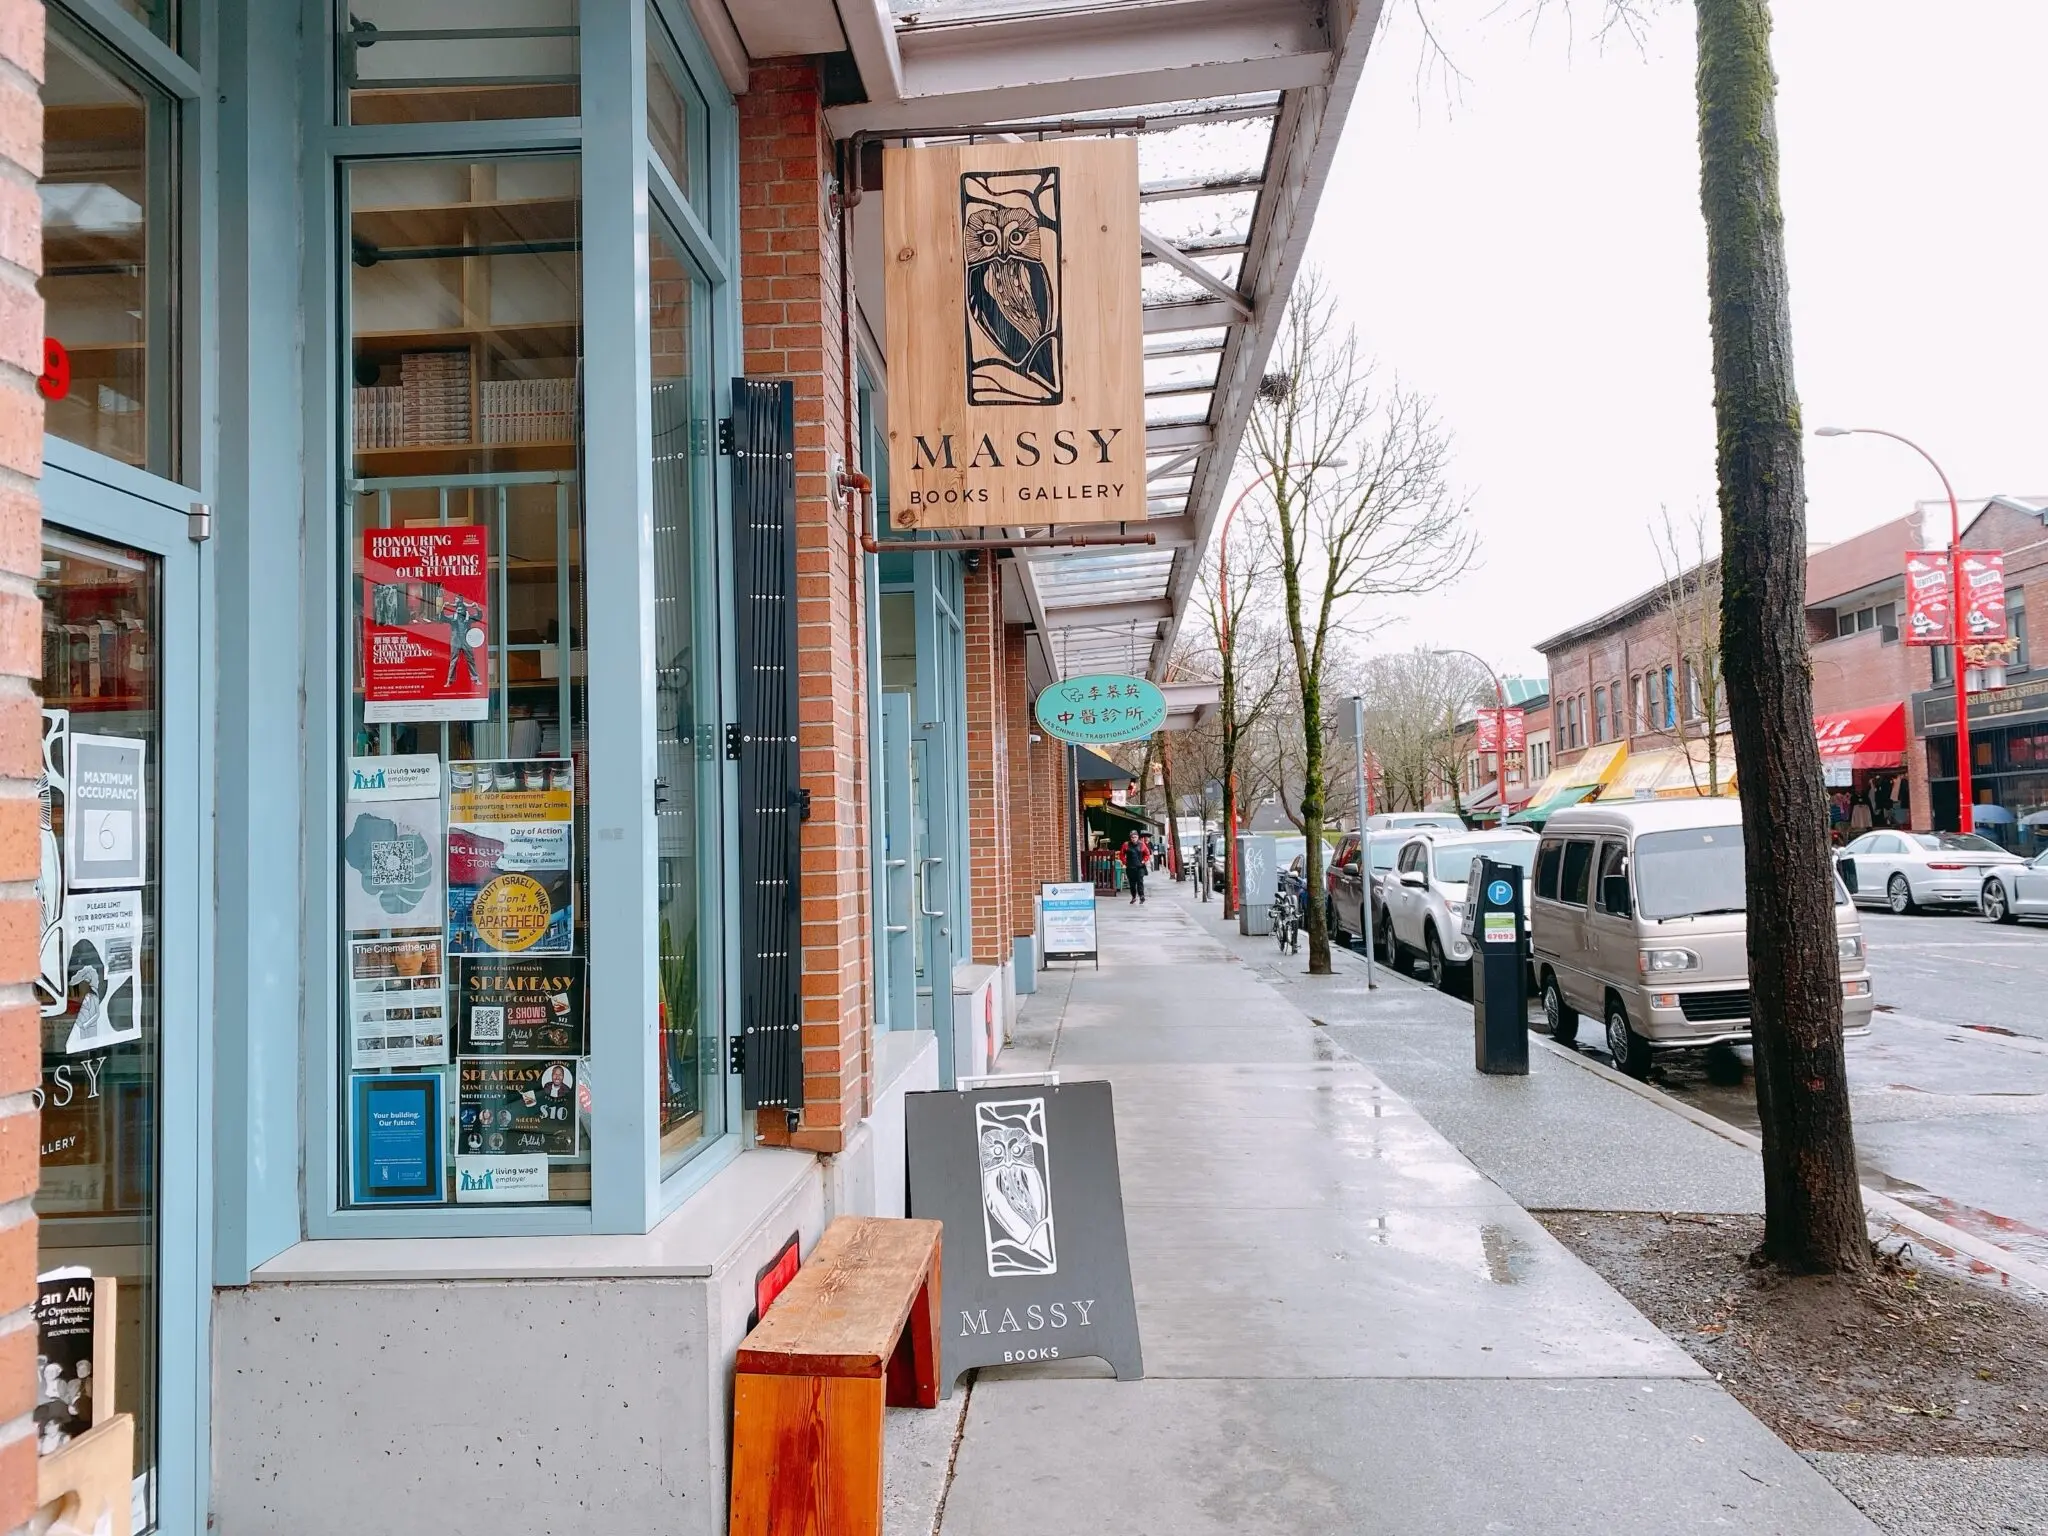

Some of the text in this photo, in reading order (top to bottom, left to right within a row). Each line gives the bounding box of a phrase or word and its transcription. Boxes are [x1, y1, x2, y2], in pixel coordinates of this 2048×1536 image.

[911, 429, 1122, 470] MASSY
[910, 483, 1124, 504] BOOKS GALLERY
[373, 535, 451, 548] HONOURING
[373, 546, 438, 558] OUR PAST.
[421, 554, 479, 567] SHAPING
[396, 564, 481, 577] OUR FUTURE.
[1086, 729, 1131, 740] TRADITIONAL
[410, 767, 430, 775] wage
[84, 771, 133, 786] MAXIMUM
[77, 786, 138, 800] OCCUPANCY
[467, 803, 504, 811] supporting
[99, 812, 115, 850] 6
[510, 828, 525, 836] Day
[450, 846, 501, 857] BC LIQUO
[476, 876, 549, 915] BOYCOTT ISRAELI WINES
[497, 893, 527, 903] Don't
[1495, 885, 1506, 900] P
[86, 902, 106, 910] PLEASE
[487, 905, 538, 913] drink with
[74, 914, 89, 922] YOUR
[90, 912, 119, 920] BROWSING
[479, 915, 544, 928] APARTHEID
[88, 924, 114, 932] MINUTES
[355, 943, 436, 954] The Cinematheque
[470, 976, 575, 991] SPEAKEASY
[470, 995, 550, 1003] STAND UP COMEDY
[507, 1006, 546, 1019] 2 SHOWS
[462, 1069, 544, 1081] SPEAKEASY
[540, 1104, 568, 1120] $10
[41, 1135, 76, 1155] LLERY
[495, 1167, 538, 1175] living wage
[41, 1287, 92, 1306] an Ally
[37, 1306, 90, 1318] of Oppression
[959, 1300, 1095, 1337] MASSY
[1003, 1347, 1059, 1363] BOOKS
